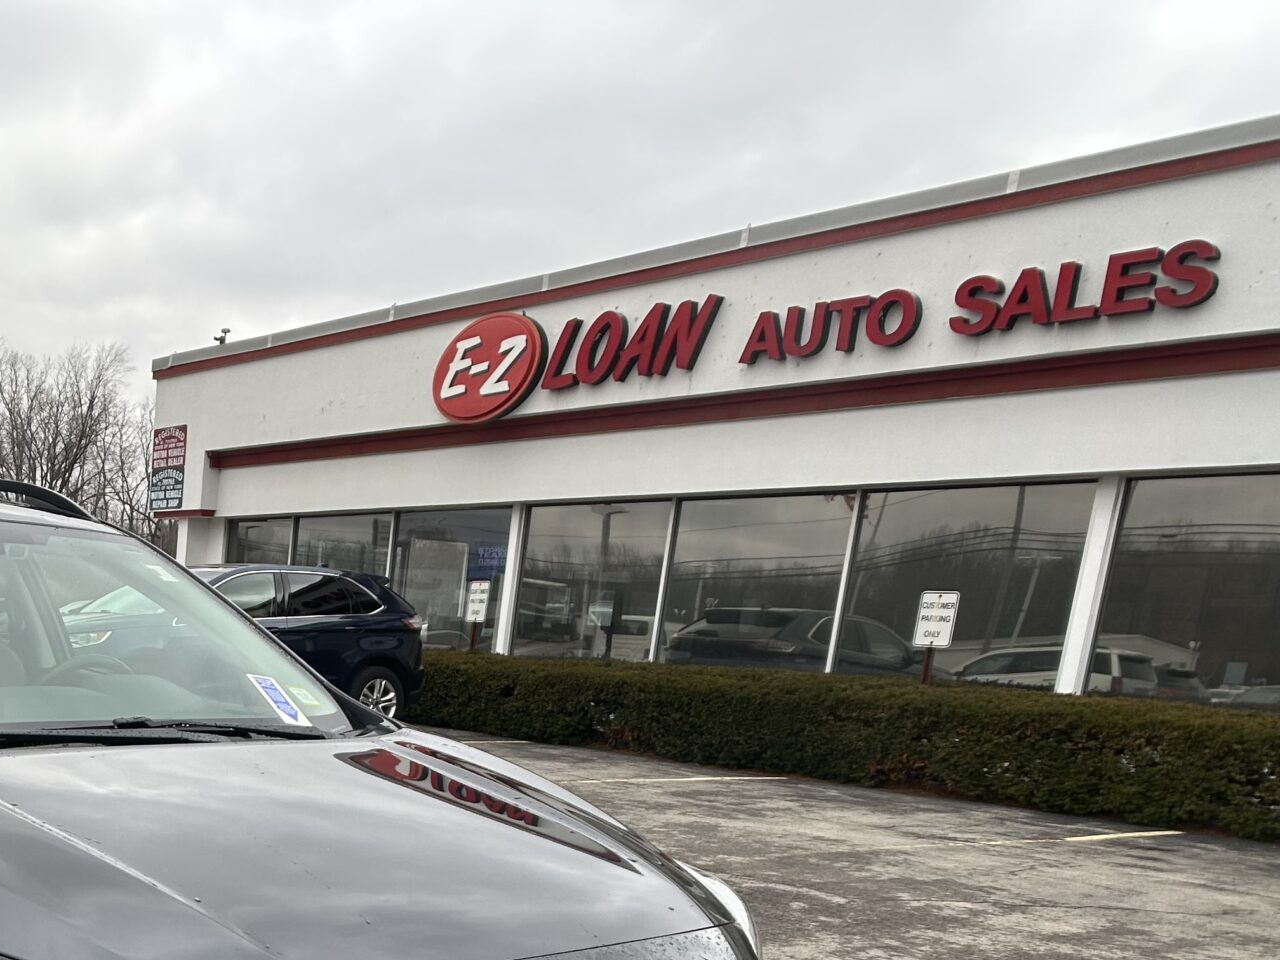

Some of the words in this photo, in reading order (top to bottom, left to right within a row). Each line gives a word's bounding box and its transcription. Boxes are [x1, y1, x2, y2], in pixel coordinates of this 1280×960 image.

[440, 334, 527, 400] E-Z
[541, 293, 724, 390] LOAN
[738, 288, 923, 365] AUTO
[949, 239, 1220, 336] SALES
[155, 428, 185, 444] REGISTERED
[152, 469, 183, 484] REGISTERED
